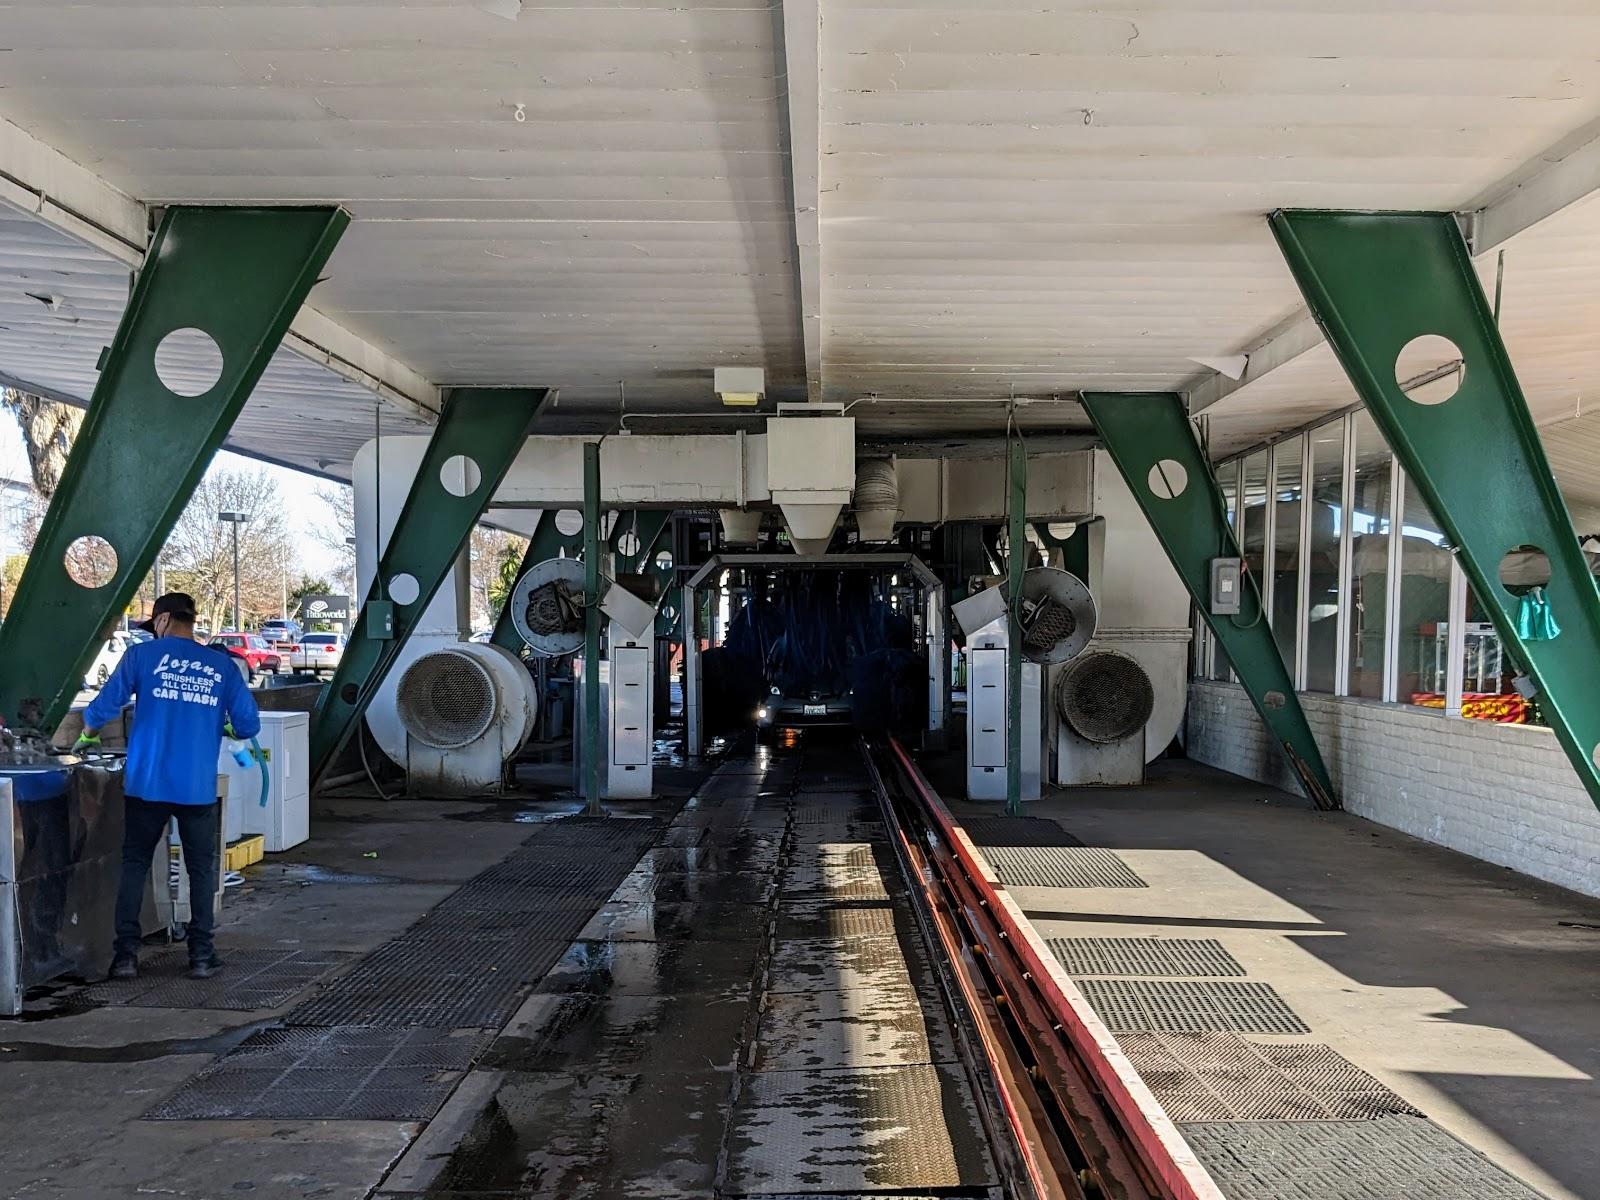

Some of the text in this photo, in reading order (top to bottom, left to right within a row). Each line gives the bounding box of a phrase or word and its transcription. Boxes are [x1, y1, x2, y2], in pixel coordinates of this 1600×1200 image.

[161, 672, 214, 687] BRUSHLESS
[162, 680, 212, 694] ALL CLOTH
[152, 687, 219, 707] CAR WASH
